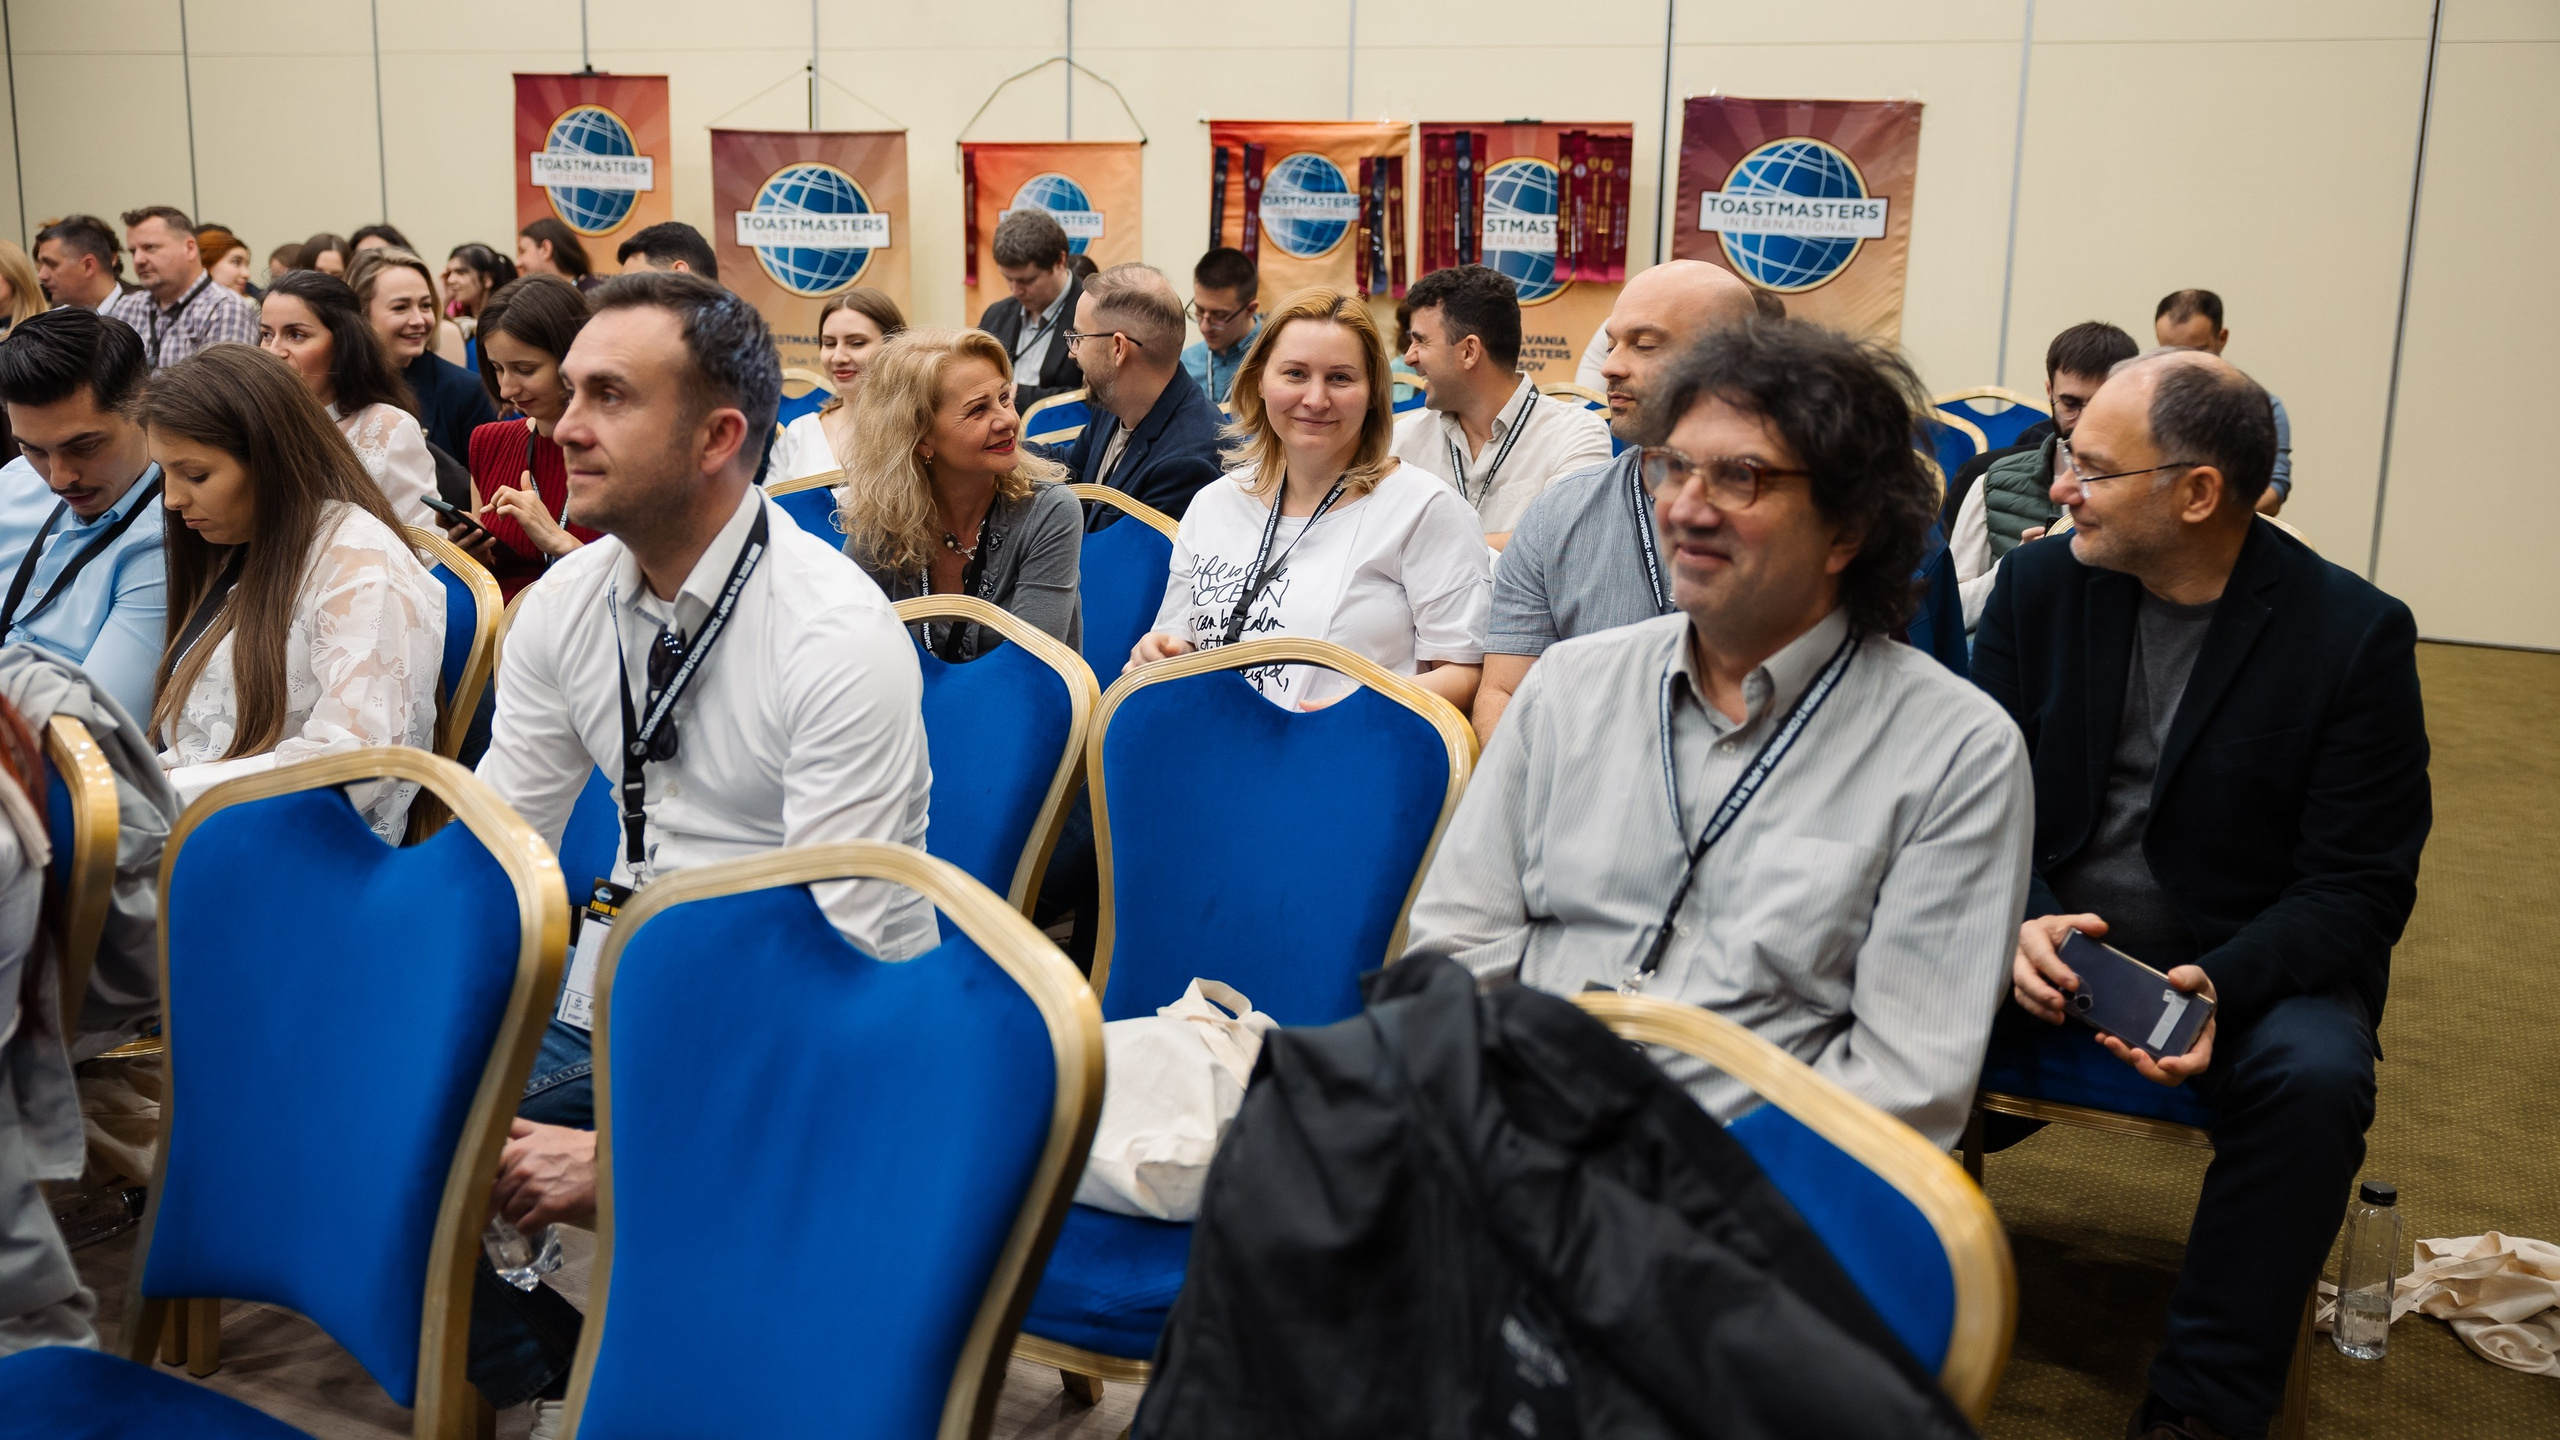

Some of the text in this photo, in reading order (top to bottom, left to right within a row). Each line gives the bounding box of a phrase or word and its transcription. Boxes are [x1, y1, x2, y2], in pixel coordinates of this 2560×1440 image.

[537, 158, 648, 174] TOASTMASTERS
[1262, 194, 1359, 208] OASTMASTERS
[1709, 198, 1879, 219] TOASTMASTERS
[742, 217, 883, 232] TOASTMASTERS
[1486, 219, 1558, 233] STMAST
[1723, 216, 1858, 233] INTERNATIONAL
[1520, 349, 1572, 360] ASTERS
[1518, 361, 1546, 371] SOV
[1196, 579, 1290, 608] OCEN
[1195, 614, 1217, 631] can
[923, 622, 932, 650] TOASTMAS
